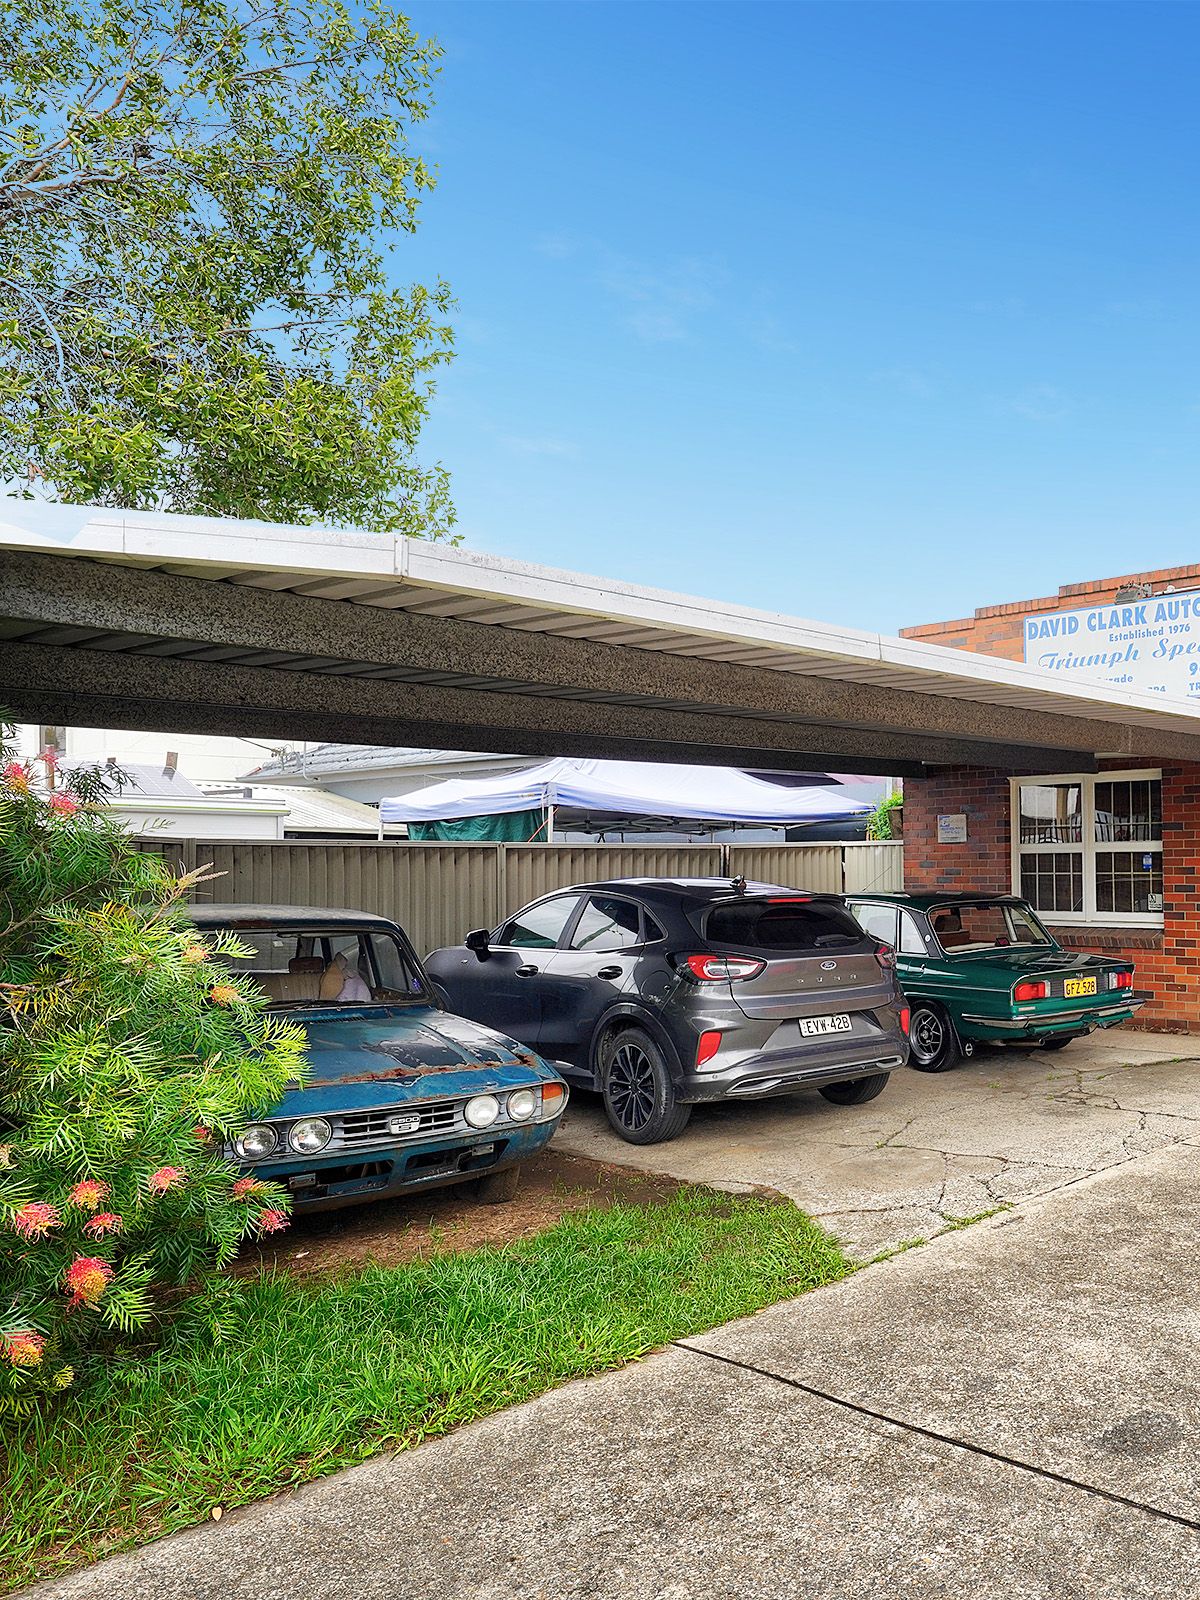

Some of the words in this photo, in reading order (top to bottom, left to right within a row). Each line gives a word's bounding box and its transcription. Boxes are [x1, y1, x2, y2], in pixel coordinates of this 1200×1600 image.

[1028, 616, 1079, 640] DAVID
[1087, 605, 1147, 632] CLARK
[1109, 625, 1164, 642] Established
[1168, 624, 1191, 635] 1976
[1038, 643, 1142, 670] Triumph
